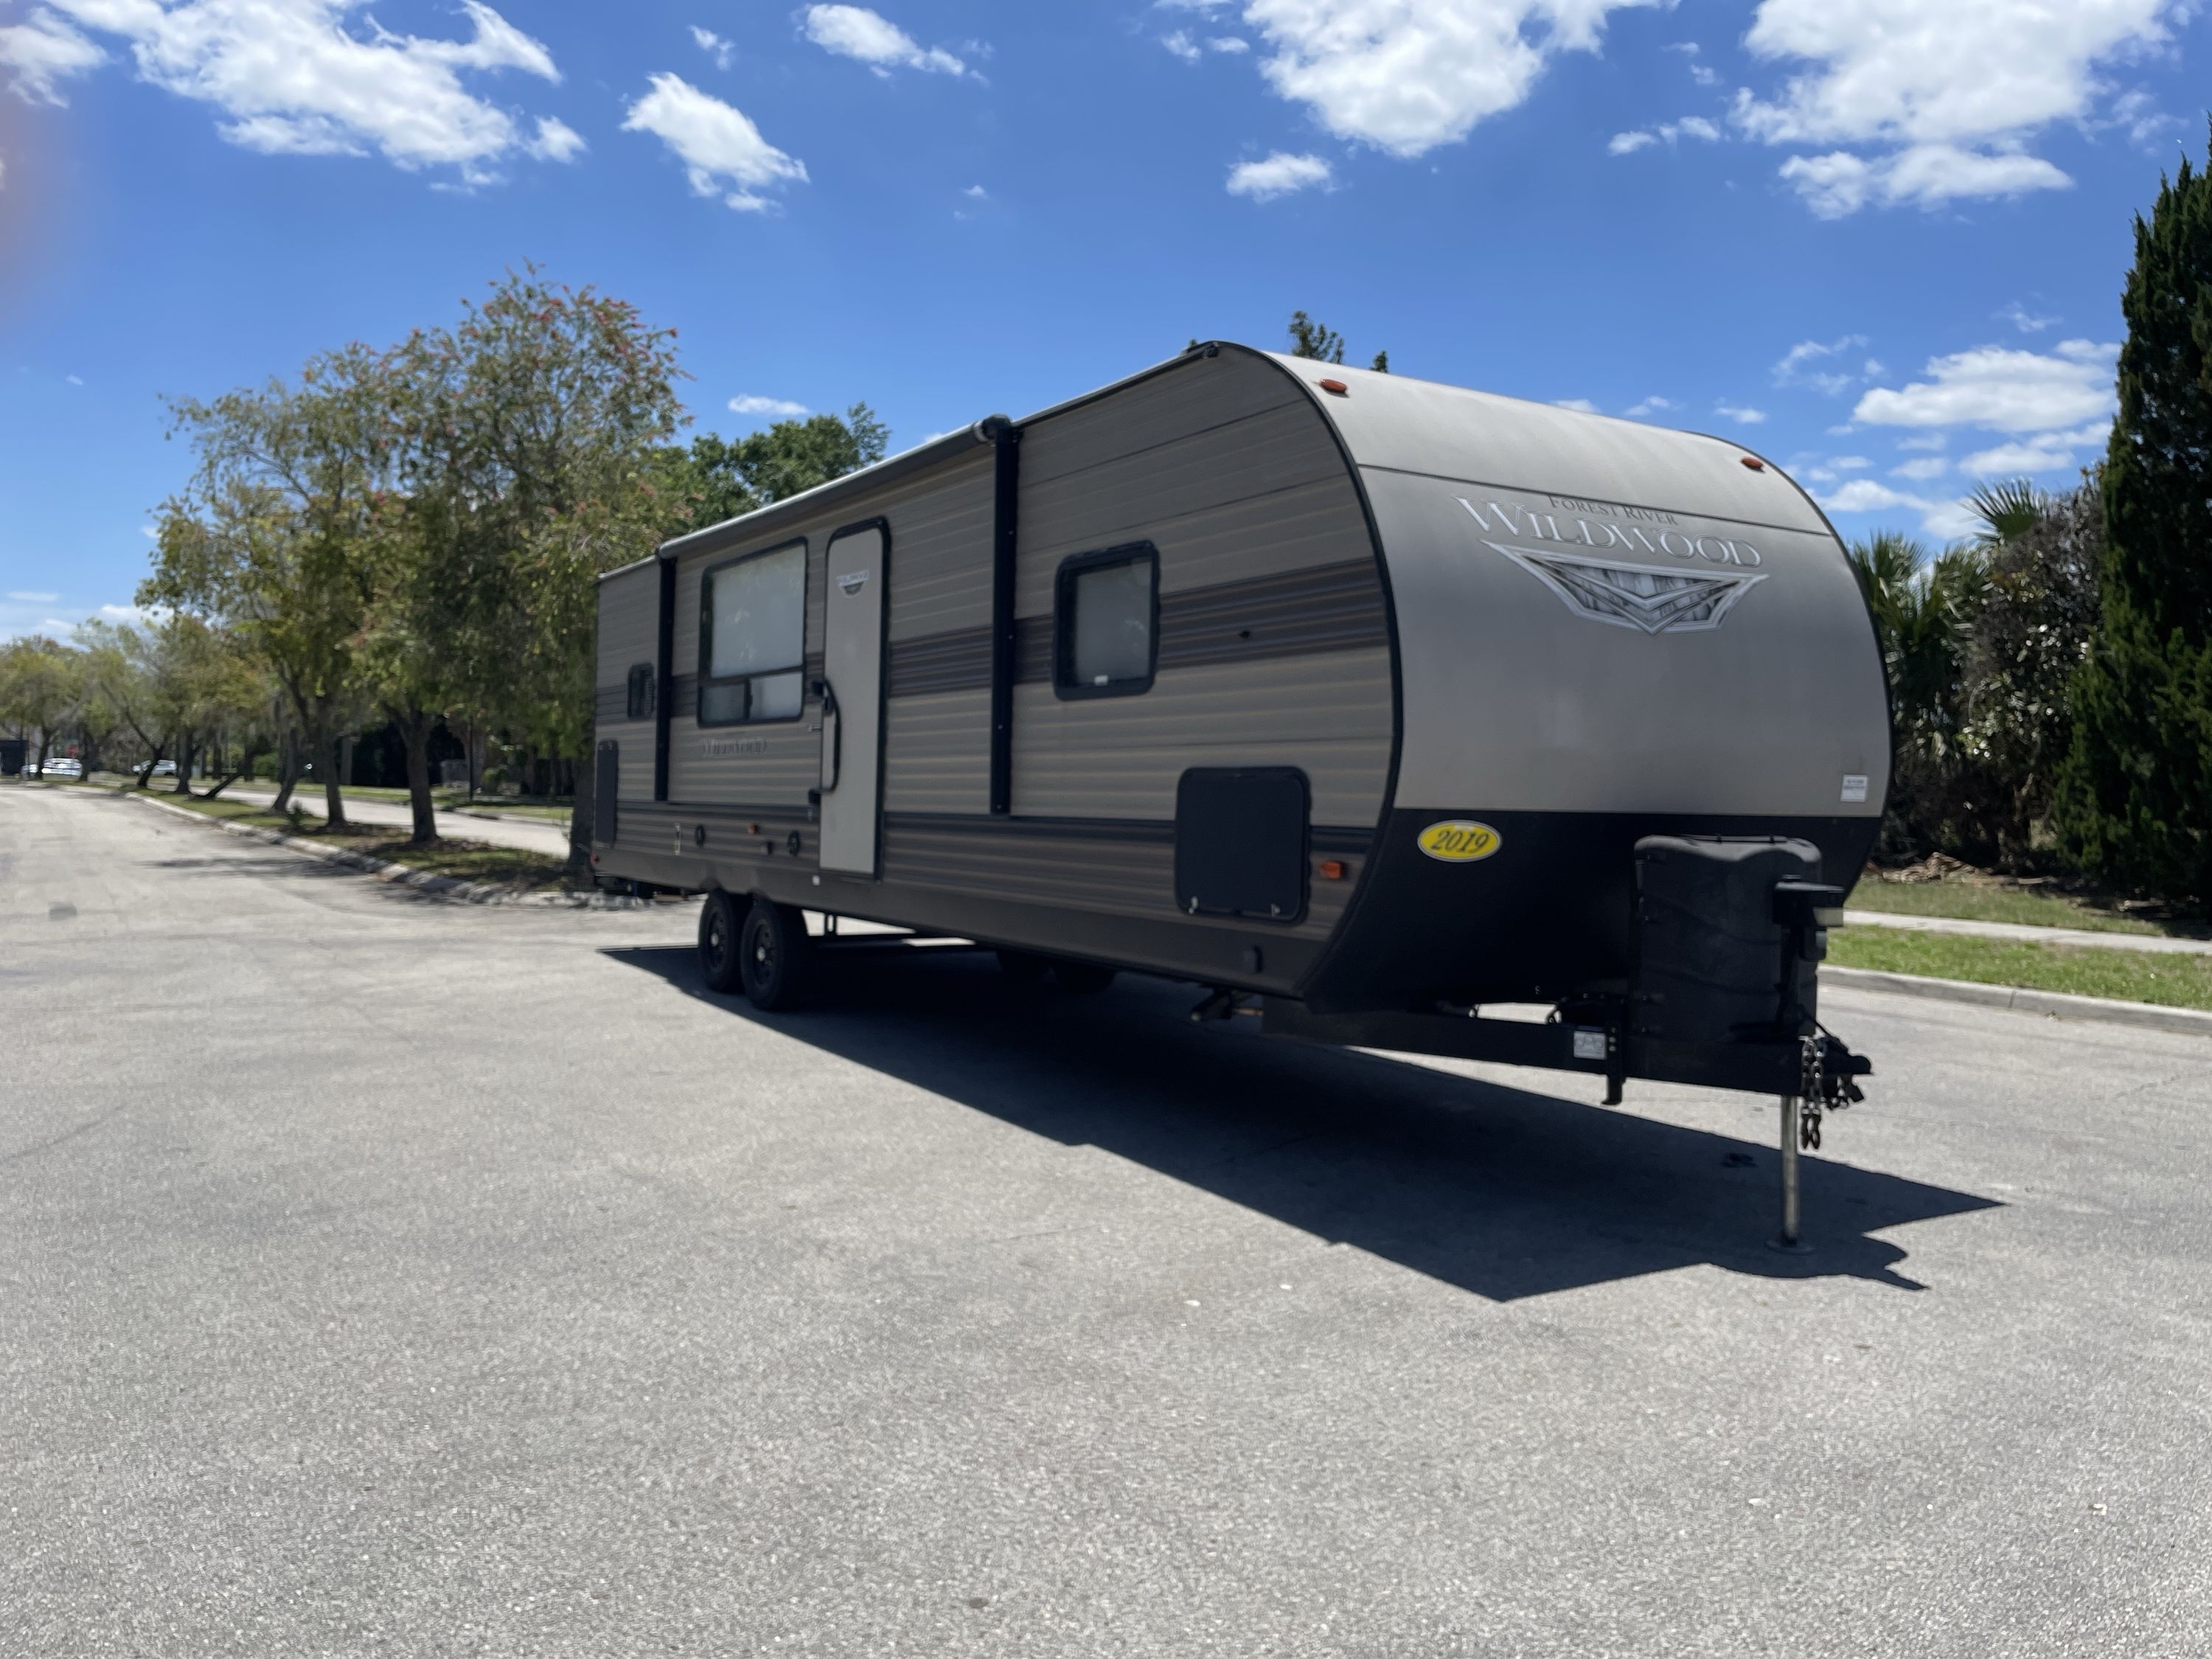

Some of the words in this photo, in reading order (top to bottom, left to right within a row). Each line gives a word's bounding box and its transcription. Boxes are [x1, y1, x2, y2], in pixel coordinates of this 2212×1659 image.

[1547, 495, 1618, 517] FOREST
[1622, 505, 1679, 526] RIVER
[1451, 493, 1762, 567] WILDWOOD
[1431, 830, 1489, 854] 2019
